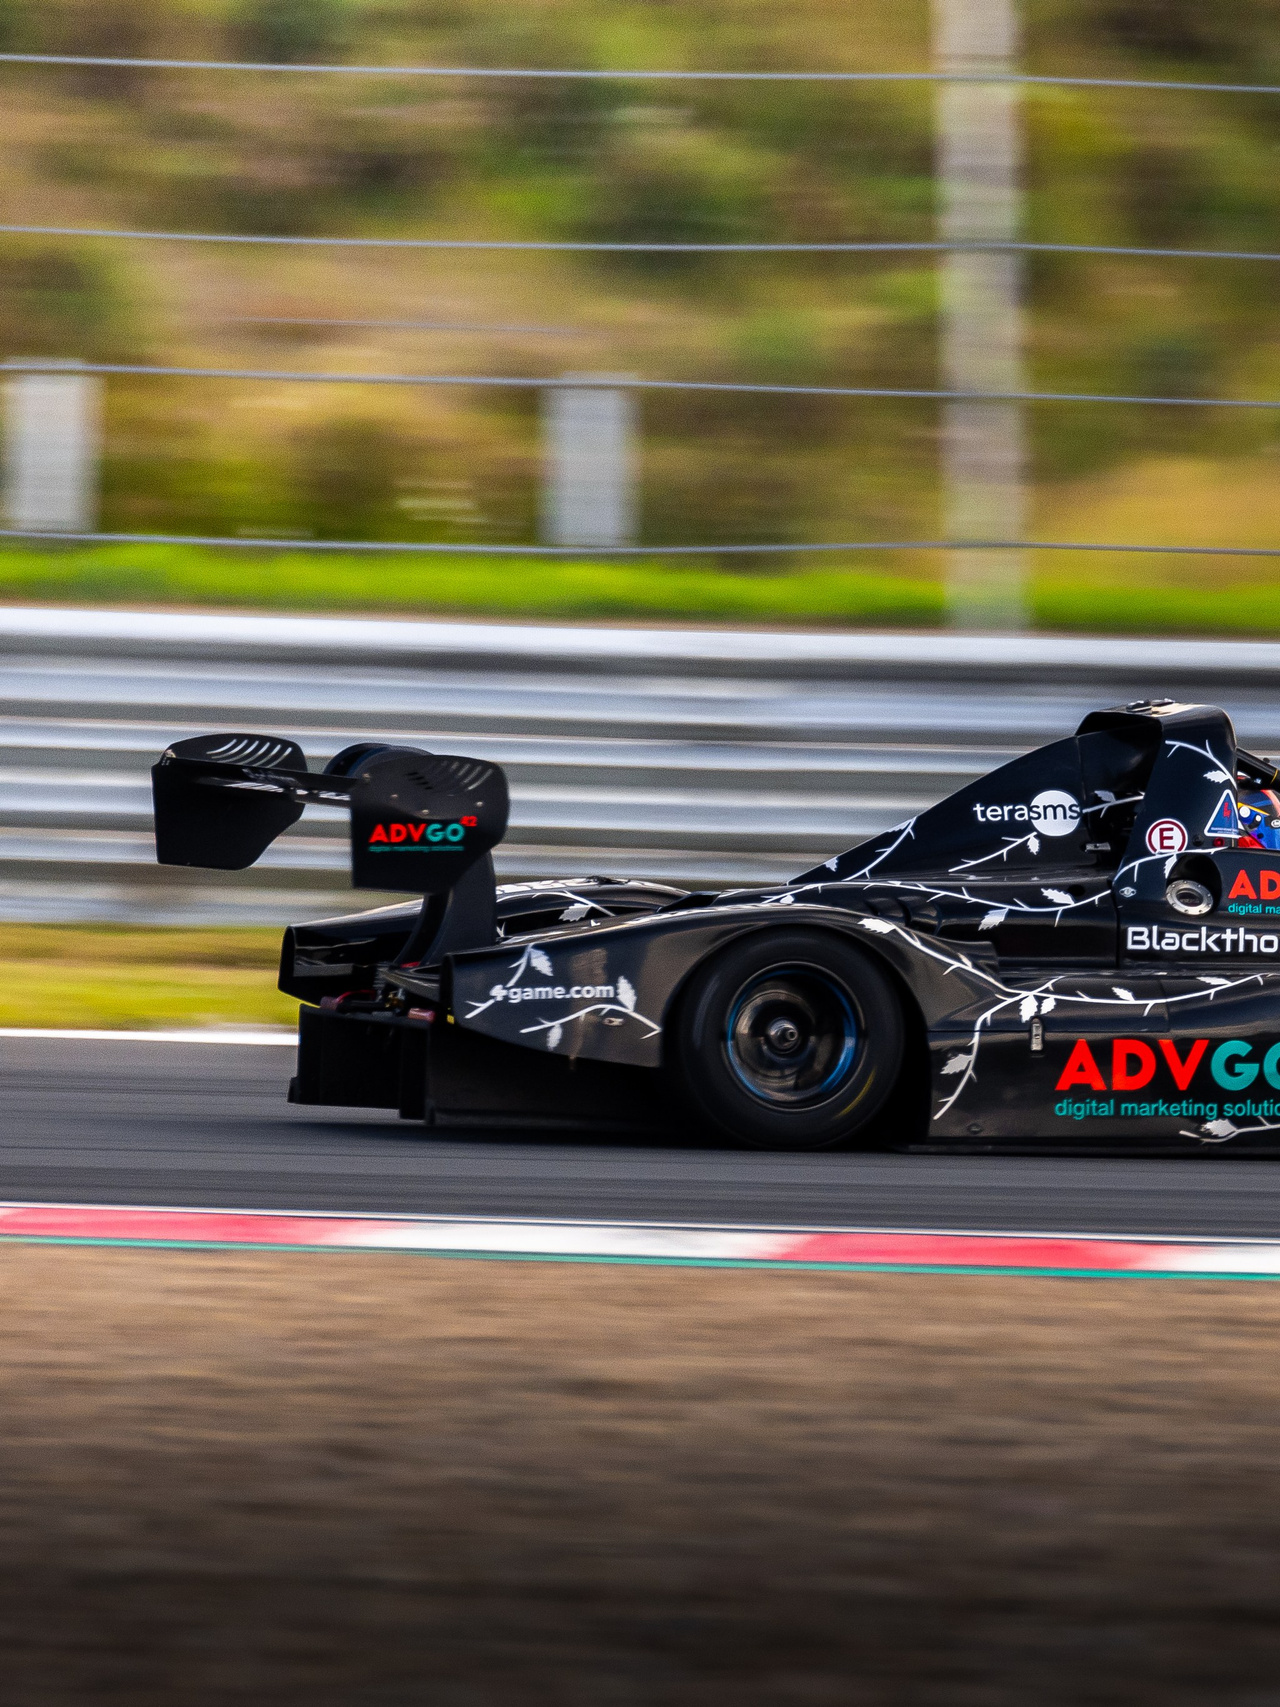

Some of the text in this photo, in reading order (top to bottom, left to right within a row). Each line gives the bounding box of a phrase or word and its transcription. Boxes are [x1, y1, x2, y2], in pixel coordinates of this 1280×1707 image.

[972, 803, 1081, 821] terasms
[1228, 903, 1262, 916] digital
[1054, 1098, 1115, 1120] digital
[1120, 1099, 1218, 1120] marketing
